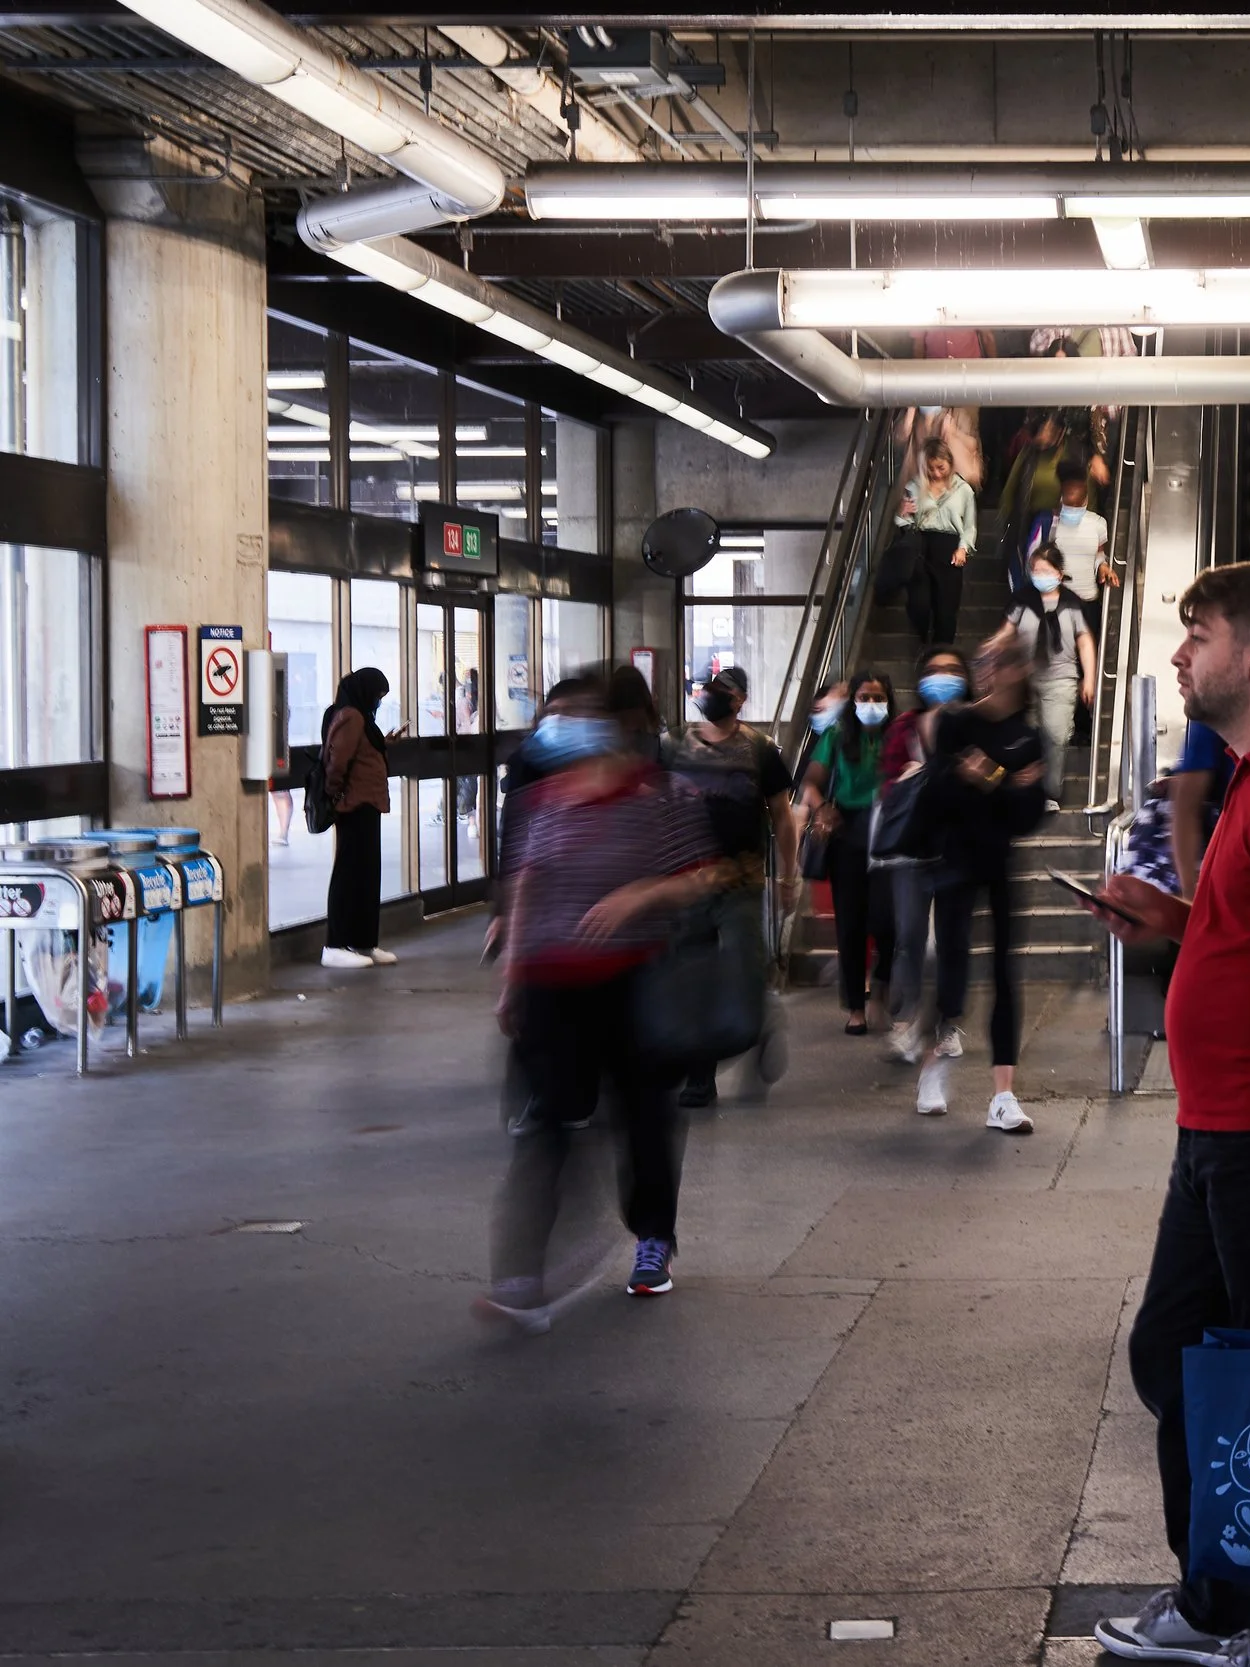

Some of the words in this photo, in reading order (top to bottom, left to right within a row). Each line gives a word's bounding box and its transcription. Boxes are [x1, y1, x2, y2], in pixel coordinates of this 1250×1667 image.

[447, 529, 459, 550] 134
[466, 531, 478, 553] 913
[210, 628, 234, 638] NOTICE
[91, 879, 114, 898] Litter
[139, 869, 167, 890] Recycle
